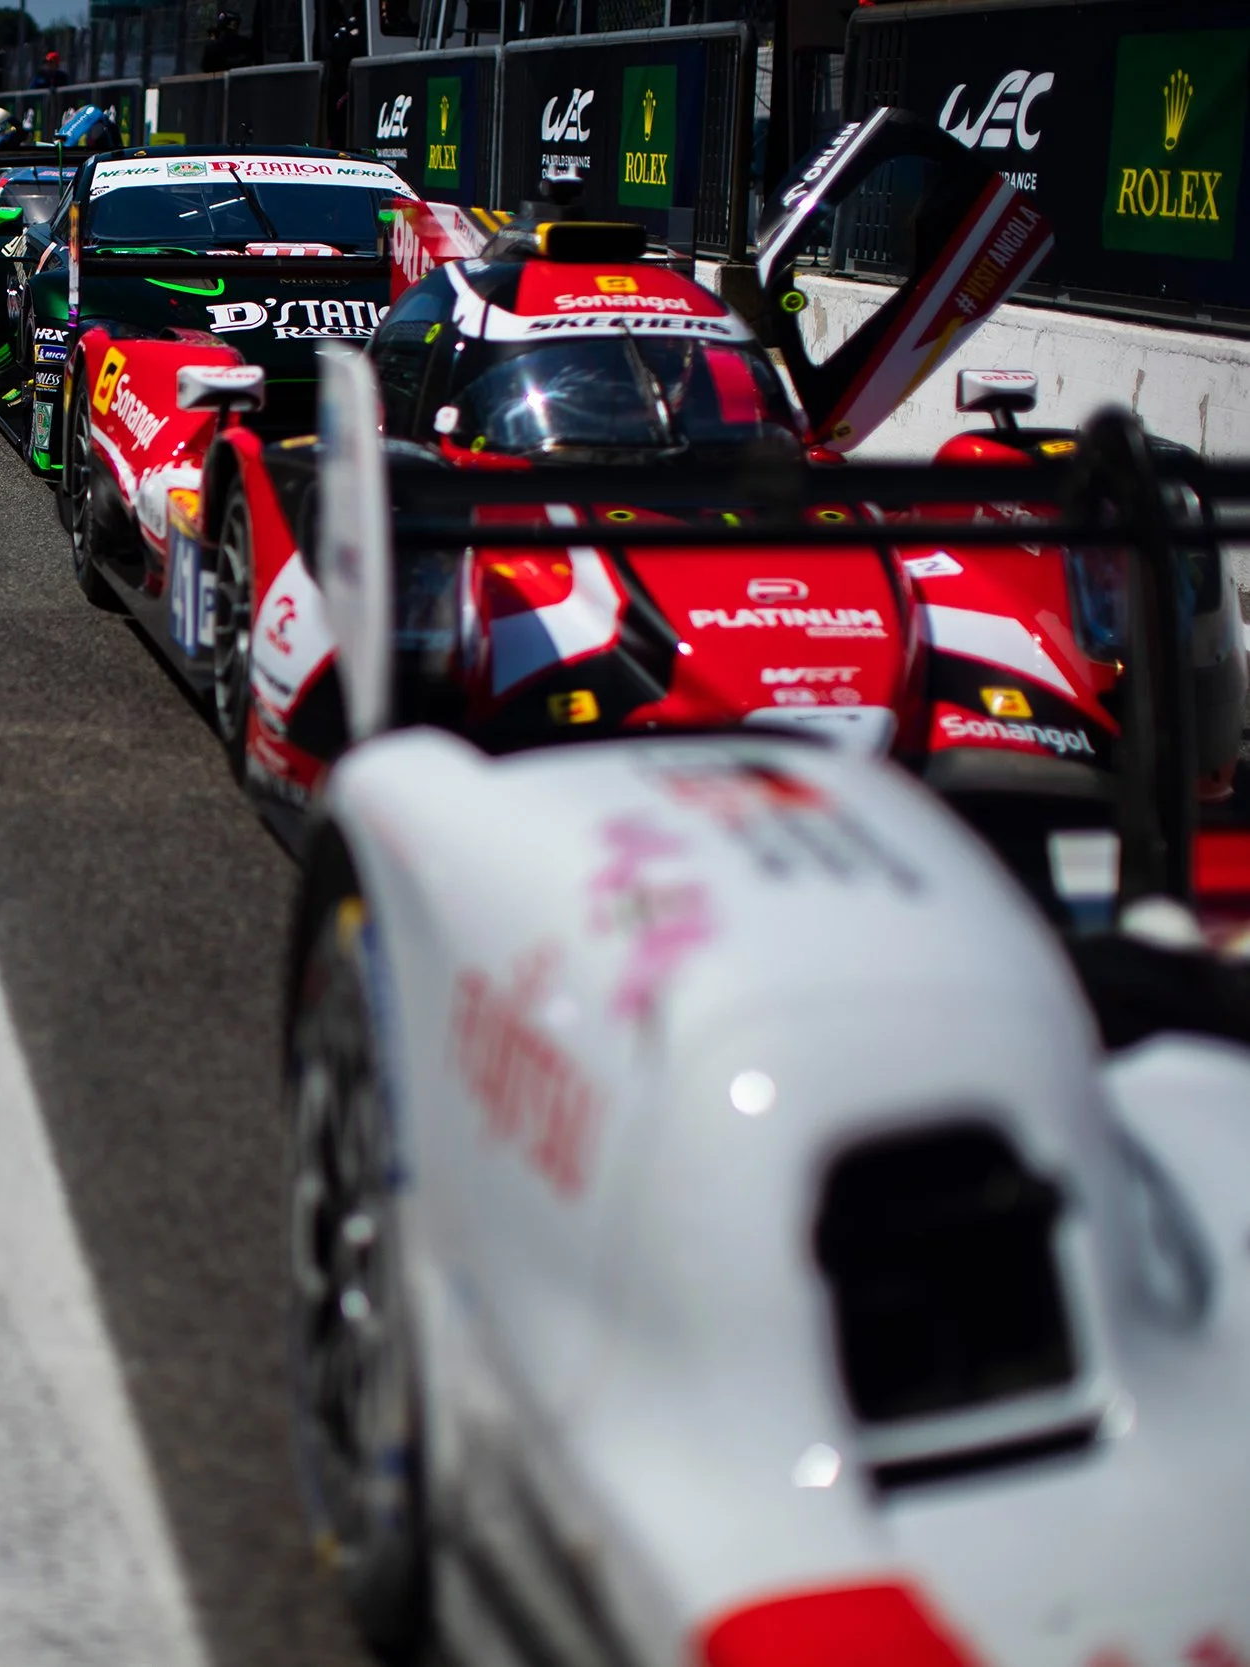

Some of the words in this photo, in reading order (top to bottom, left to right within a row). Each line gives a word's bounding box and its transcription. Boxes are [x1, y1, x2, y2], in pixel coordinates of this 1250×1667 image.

[376, 94, 413, 139] WEC
[541, 87, 595, 142] WEC
[938, 69, 1055, 151] WEC
[428, 144, 457, 171] ROLEX
[802, 121, 862, 183] ORLEN
[96, 166, 161, 179] NEXUS
[336, 166, 395, 180] NEXUS
[624, 151, 668, 186] ROLEX
[1116, 167, 1223, 222] ROLEX
[553, 293, 693, 313] Sonangol
[273, 326, 382, 340] RACIN
[524, 316, 732, 336] SKECHERS
[981, 374, 1035, 382] ORLEN
[110, 373, 170, 451] Sonangol
[687, 607, 885, 630] PLATINUM
[759, 665, 863, 685] WRT
[938, 712, 1096, 756] Sonangol
